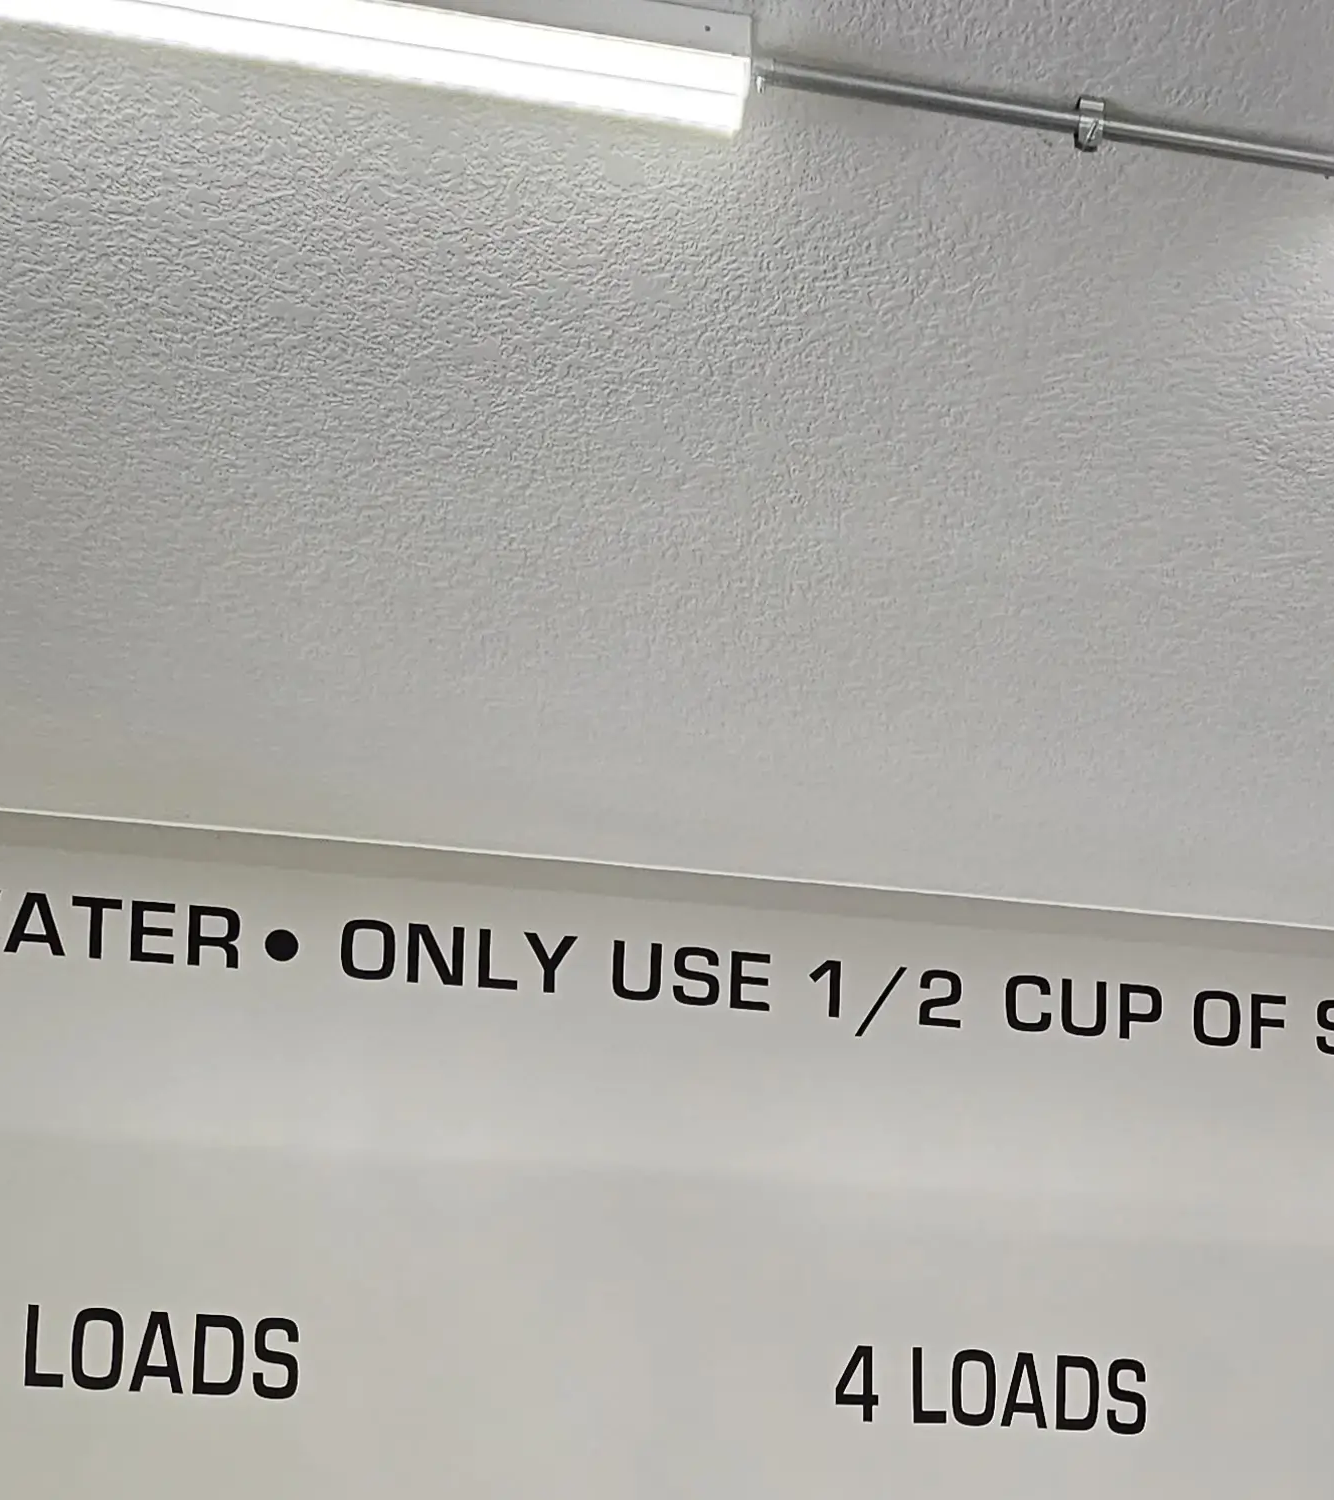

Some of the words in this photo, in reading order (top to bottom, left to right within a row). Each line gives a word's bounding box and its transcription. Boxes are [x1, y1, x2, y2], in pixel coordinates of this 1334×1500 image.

[340, 919, 578, 994] ONLY
[612, 939, 771, 1012] USE
[809, 959, 962, 1037] 1/2
[1005, 975, 1163, 1040] CUP
[1193, 990, 1287, 1049] OF
[24, 1303, 299, 1400] LOADS
[835, 1345, 879, 1423] 4
[912, 1346, 1147, 1435] LOADS
